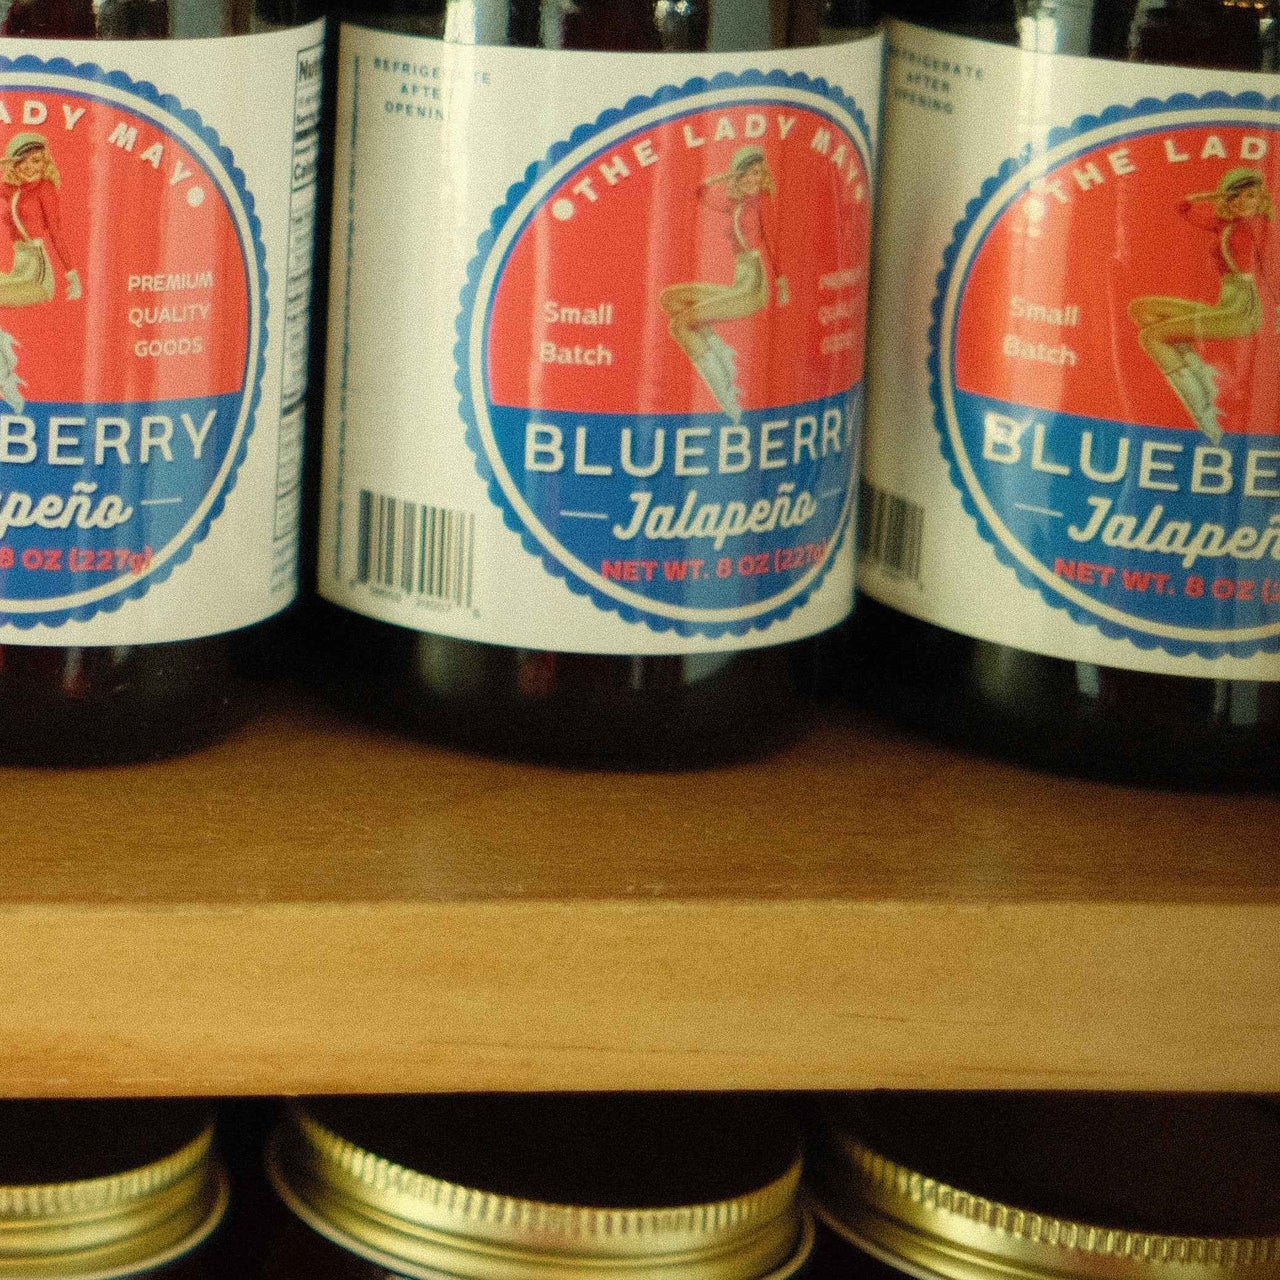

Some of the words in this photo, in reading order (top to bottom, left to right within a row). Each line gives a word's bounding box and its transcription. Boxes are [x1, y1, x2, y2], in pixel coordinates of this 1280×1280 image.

[106, 120, 195, 185] MAY
[572, 135, 660, 204] THE
[681, 114, 797, 150] LADY
[810, 126, 861, 189] MAY
[1039, 146, 1137, 205] THE
[127, 270, 216, 295] PREMIUM
[127, 300, 211, 328] QUALITY
[541, 299, 615, 327] Small
[1007, 295, 1082, 328] Small
[133, 335, 204, 359] GOODS
[538, 341, 615, 369] Batch
[1002, 333, 1079, 367] Batch
[611, 483, 819, 551] Jalapeño
[22, 546, 66, 573] OZ
[68, 545, 156, 577] (227g)
[600, 558, 660, 584] NET
[663, 558, 711, 583] WT.
[715, 557, 733, 579] 8
[739, 552, 773, 577] OZ
[1054, 556, 1116, 588] NET
[1121, 571, 1177, 597] WT.
[1183, 575, 1206, 599] 8
[1210, 578, 1255, 602] OZ
